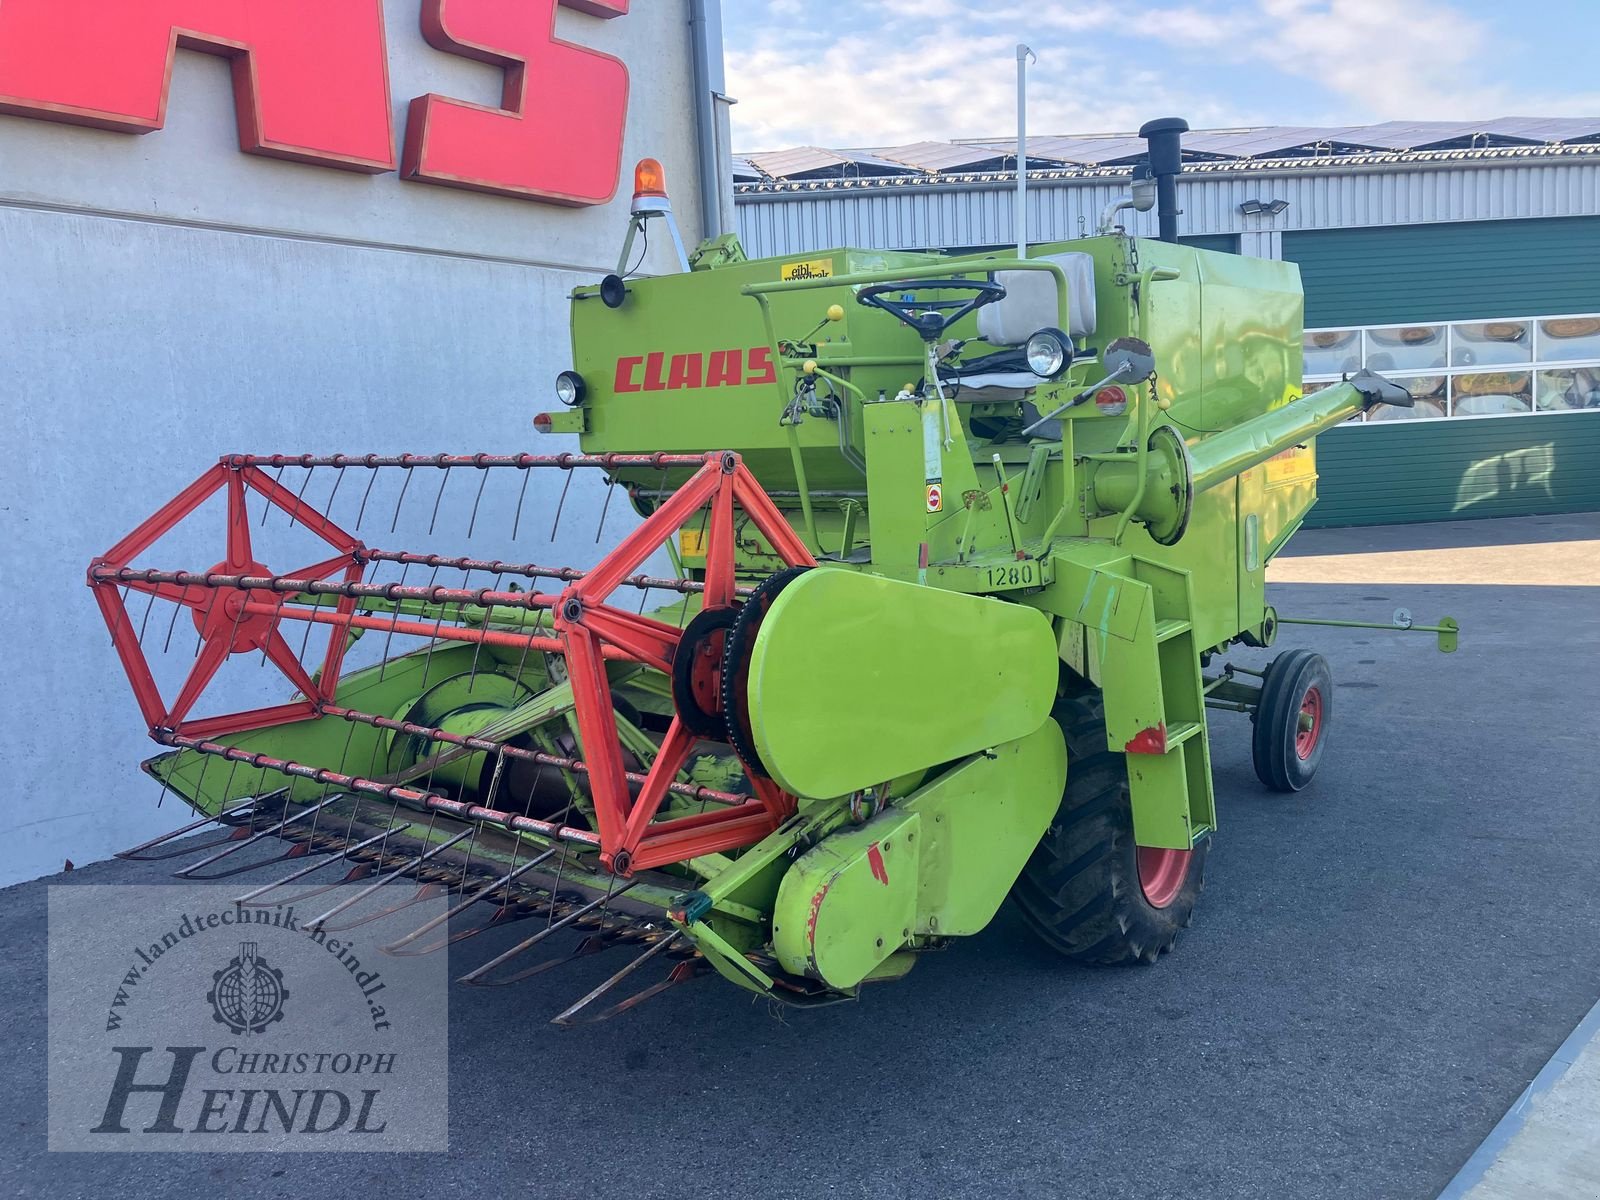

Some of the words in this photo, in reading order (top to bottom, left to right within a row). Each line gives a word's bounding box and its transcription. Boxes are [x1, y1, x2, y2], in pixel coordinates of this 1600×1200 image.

[791, 263, 809, 277] eibl
[613, 346, 777, 393] CLAAS
[986, 564, 1033, 587] 1280
